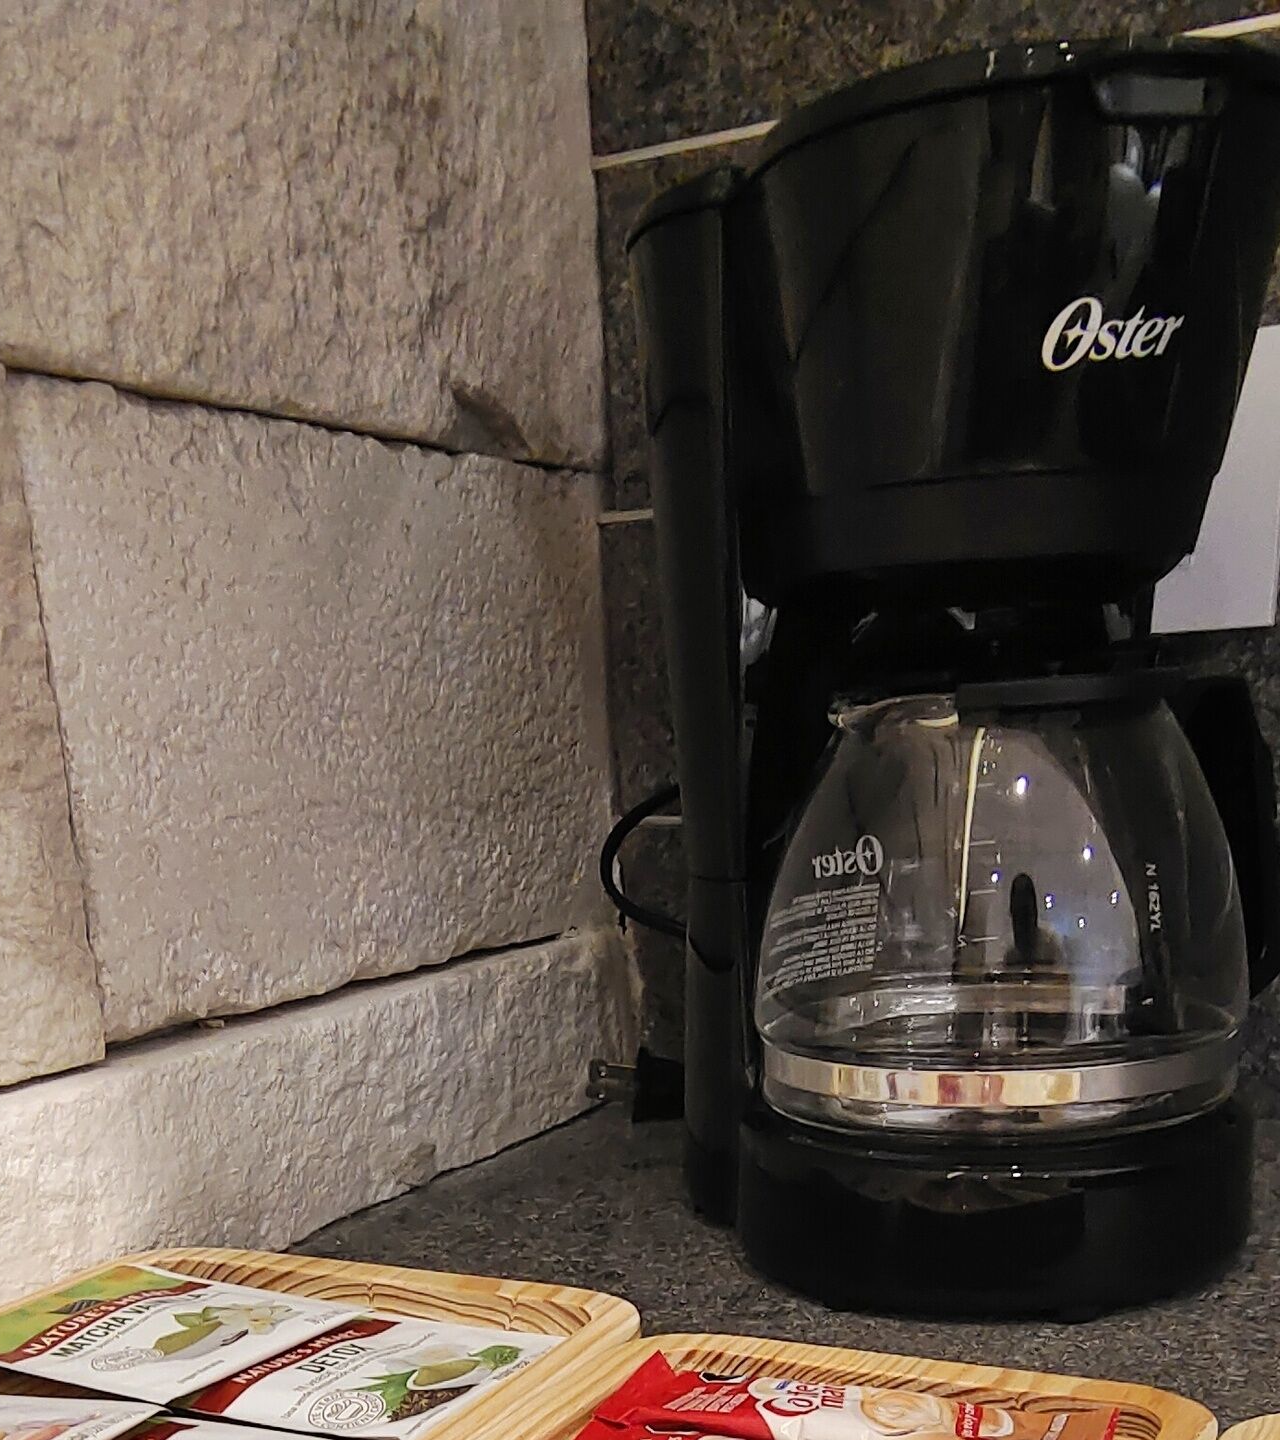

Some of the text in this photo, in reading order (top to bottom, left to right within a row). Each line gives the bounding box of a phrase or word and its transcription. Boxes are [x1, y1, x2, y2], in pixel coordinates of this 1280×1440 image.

[1041, 297, 1184, 372] Oster
[50, 1315, 131, 1357] MATCHA
[294, 1342, 377, 1374] DETOX
